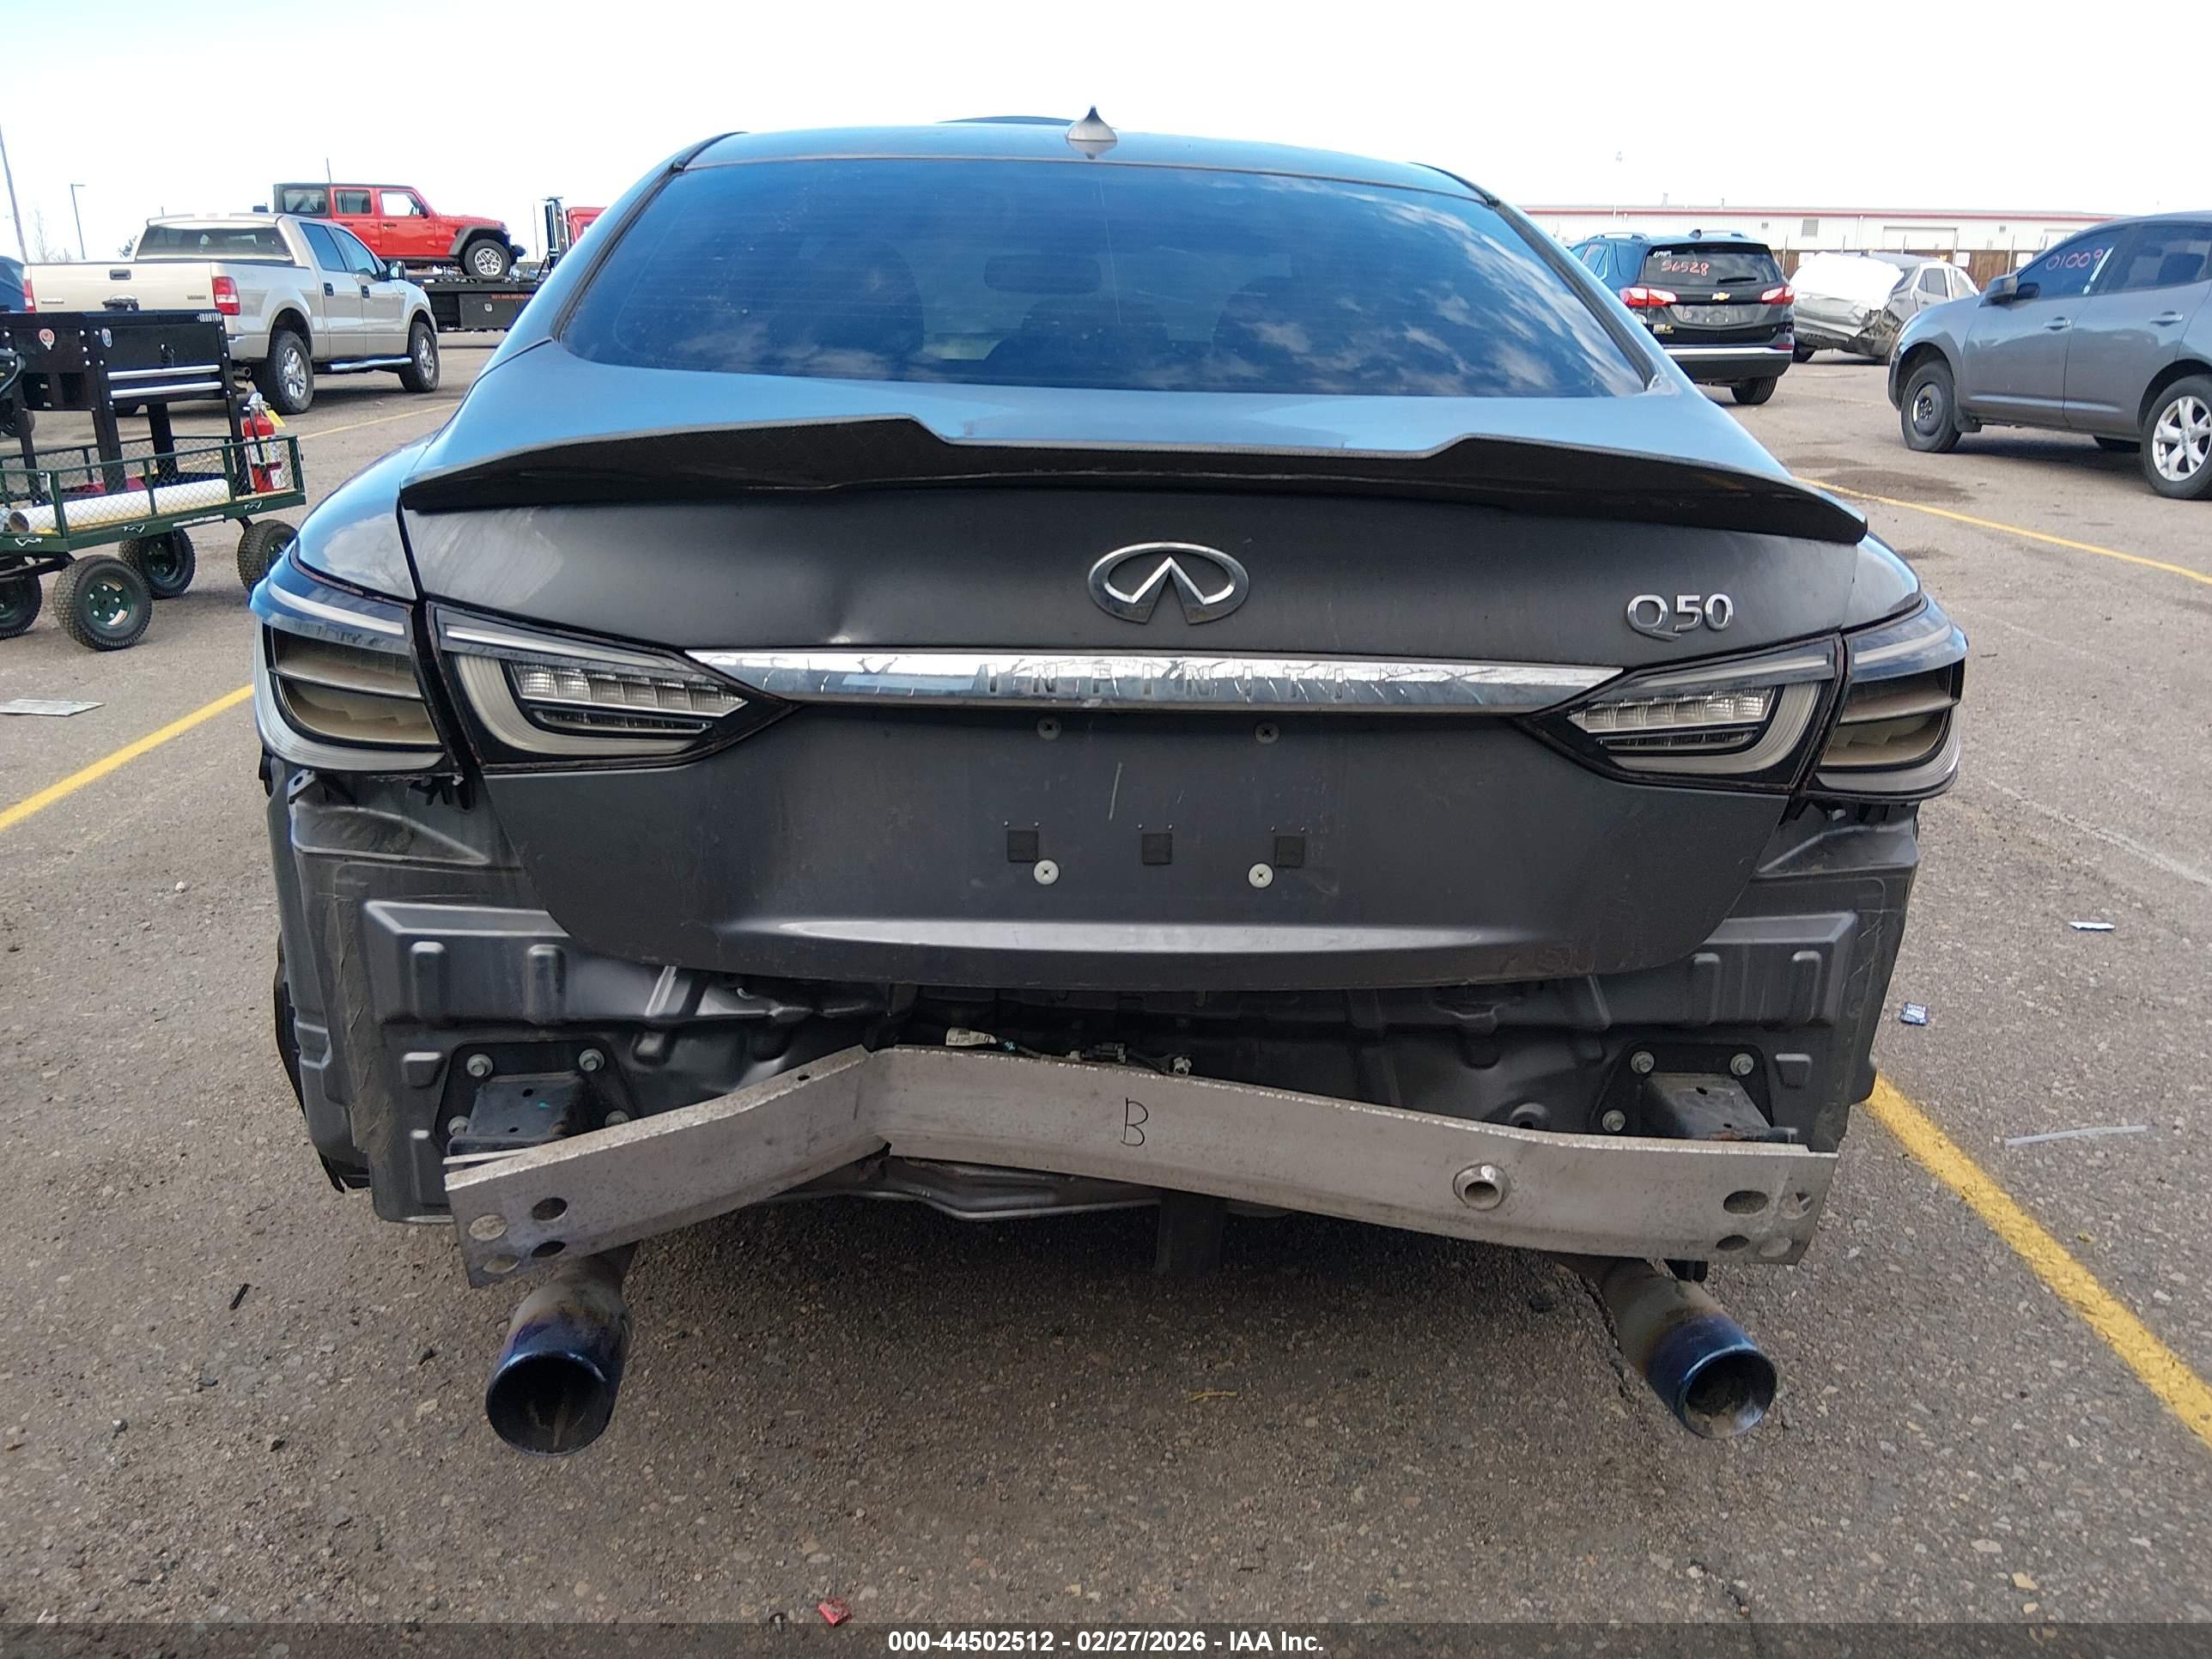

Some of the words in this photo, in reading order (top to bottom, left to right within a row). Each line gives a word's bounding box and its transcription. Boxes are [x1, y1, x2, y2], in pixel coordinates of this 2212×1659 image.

[2045, 247, 2103, 270] 01009
[1627, 592, 1734, 641] Q50
[988, 663, 1344, 701] INFINITI
[1120, 1097, 1149, 1146] B
